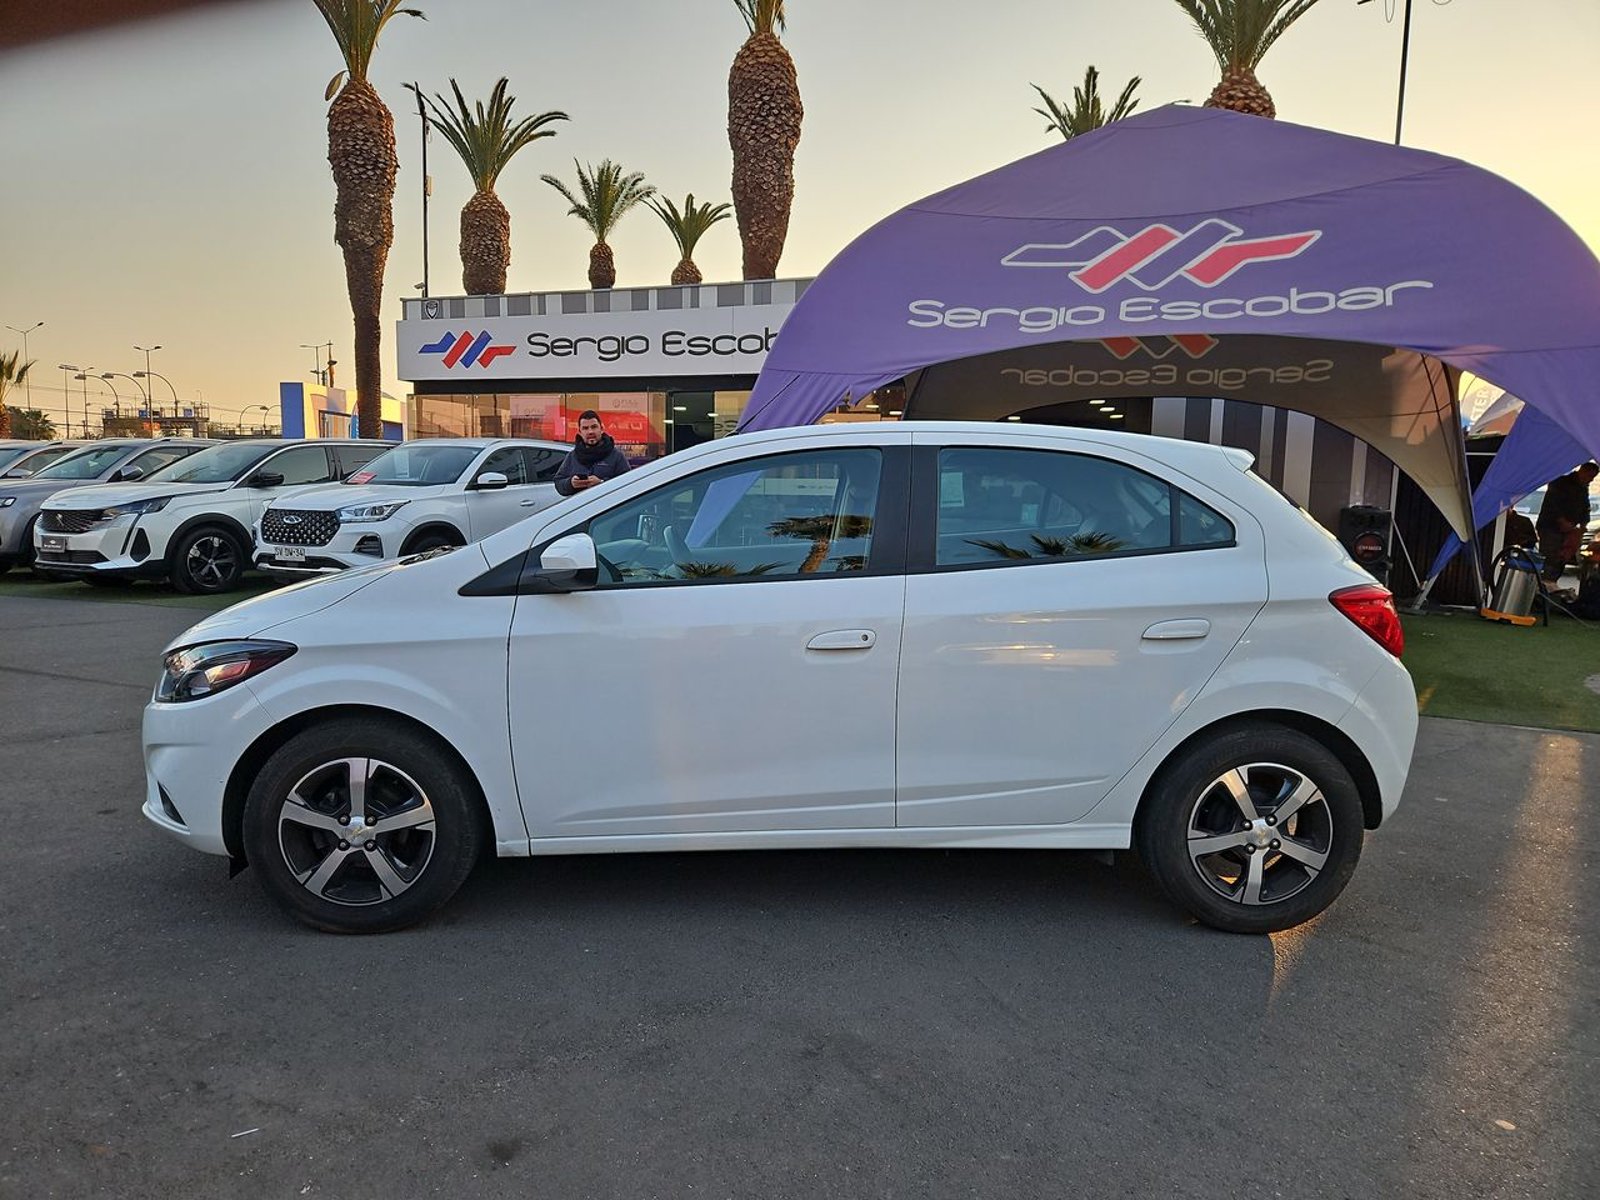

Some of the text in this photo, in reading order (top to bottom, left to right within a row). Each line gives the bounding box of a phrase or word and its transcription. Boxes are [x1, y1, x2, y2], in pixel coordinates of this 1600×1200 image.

[907, 281, 1434, 334] Sergio Escobar
[527, 332, 649, 361] Sergio
